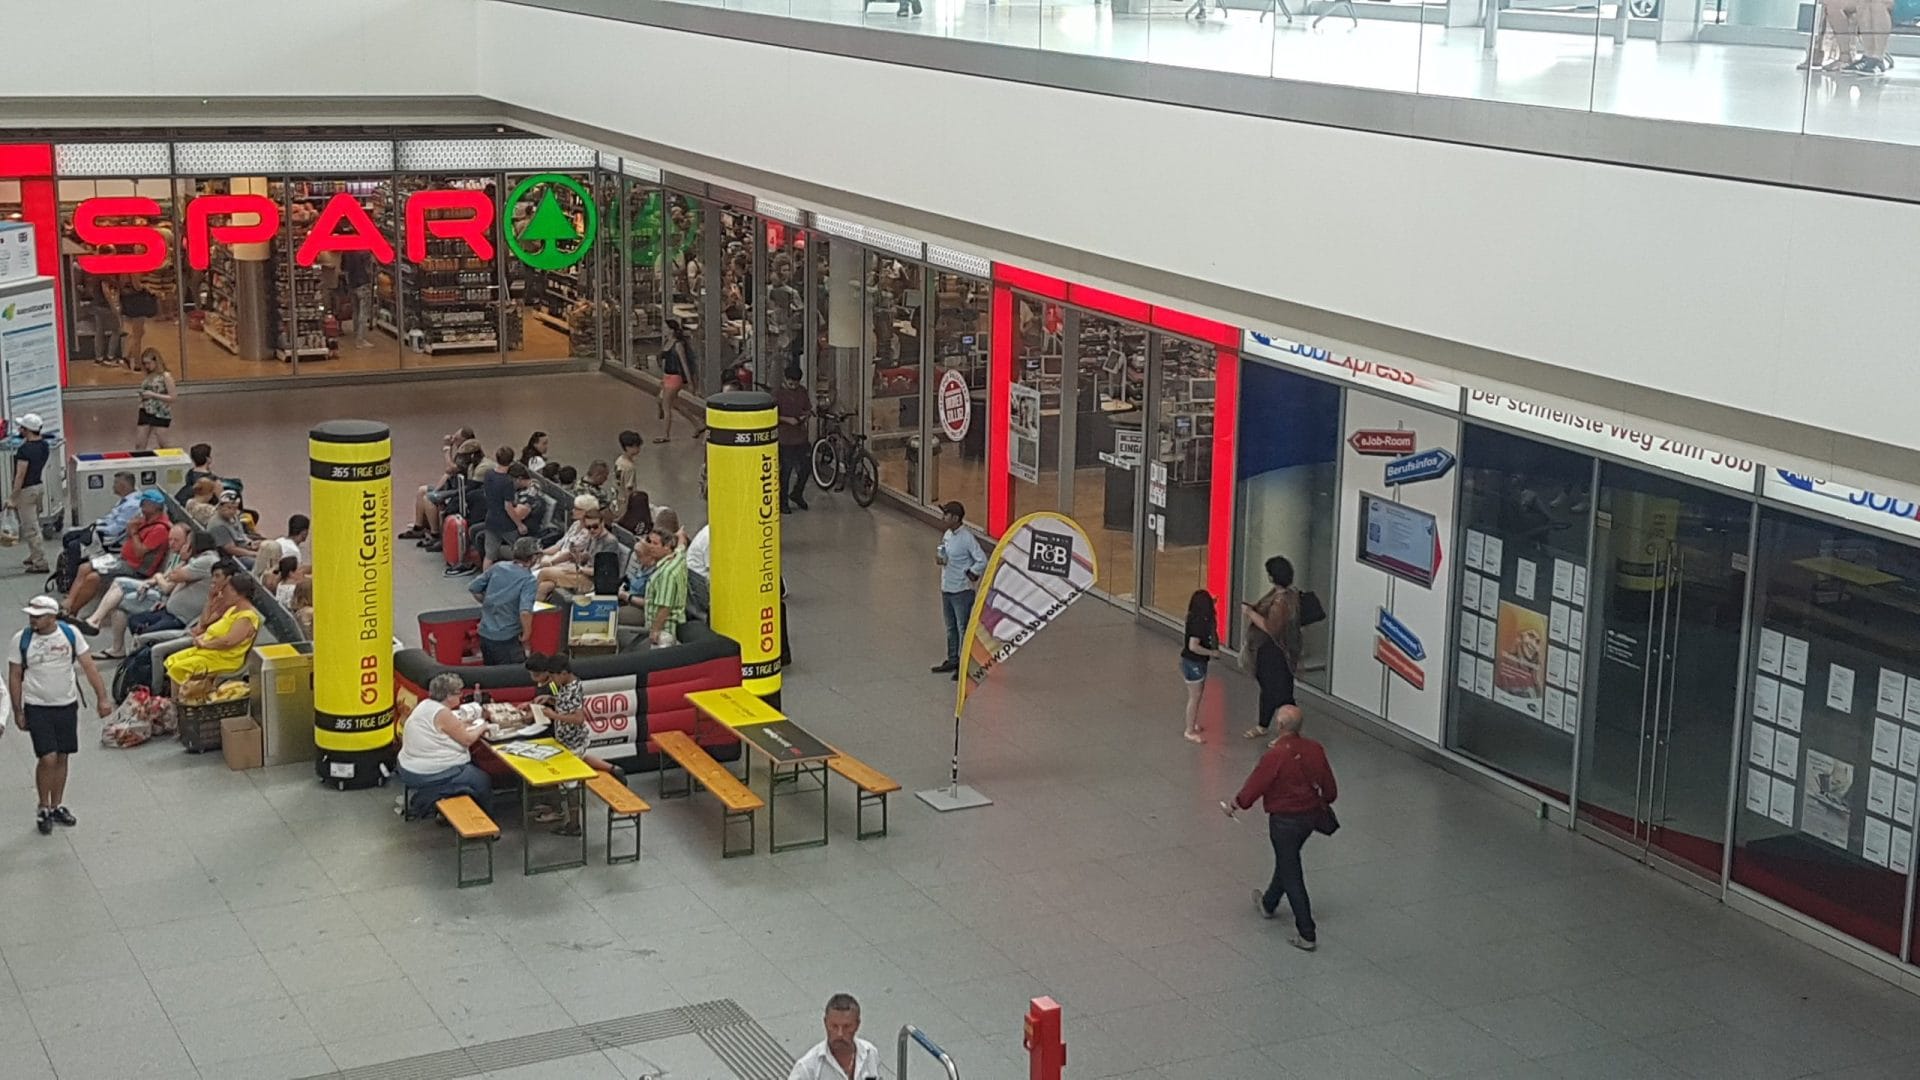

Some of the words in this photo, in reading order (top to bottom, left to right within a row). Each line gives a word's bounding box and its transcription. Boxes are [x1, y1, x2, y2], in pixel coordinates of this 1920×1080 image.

[73, 190, 495, 274] SPAR
[1387, 457, 1438, 477] Berufsinfos
[1660, 437, 1704, 461] zum
[759, 453, 773, 593] BahnhofCenter
[358, 490, 378, 640] BahnhofCenter
[1033, 541, 1067, 566] R&B
